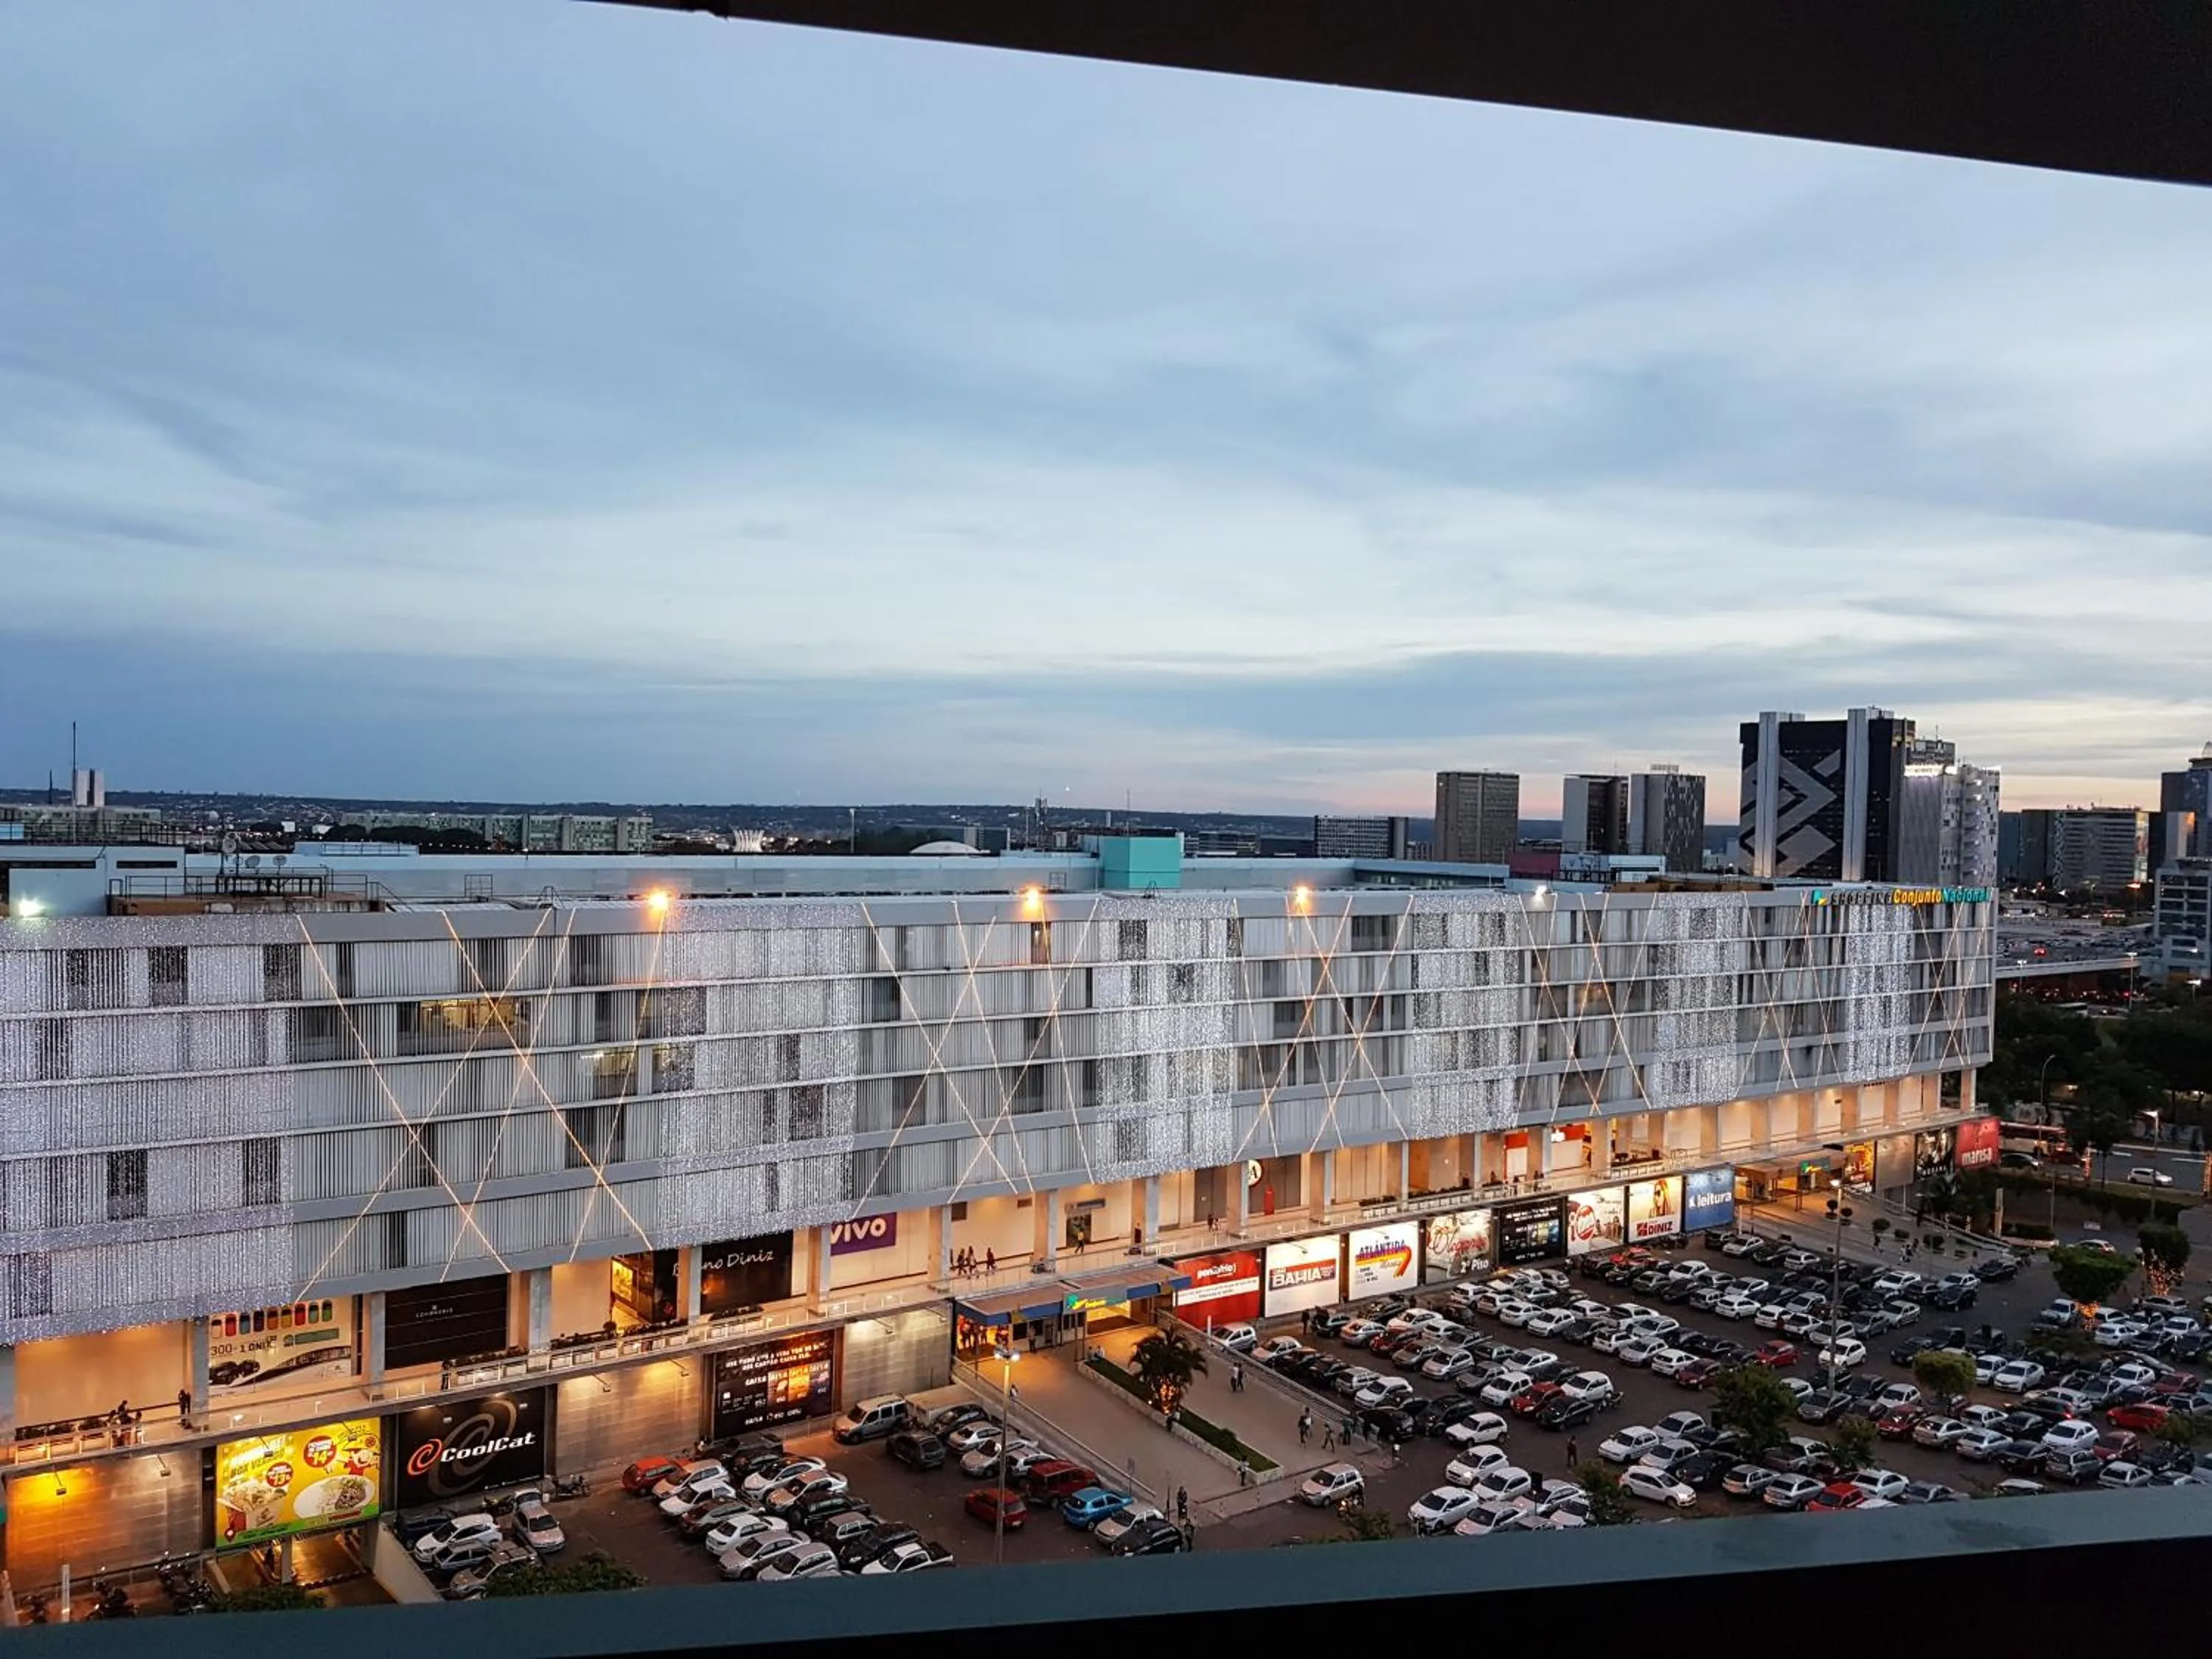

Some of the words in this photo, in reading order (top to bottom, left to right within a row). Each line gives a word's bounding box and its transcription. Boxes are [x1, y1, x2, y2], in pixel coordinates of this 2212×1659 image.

[1962, 1147, 1992, 1165] marisa
[1697, 1192, 1732, 1207] leitura
[1648, 1221, 1673, 1235] DINIZ
[727, 1249, 773, 1267] Diniz
[1272, 1267, 1322, 1287] BAHIA
[440, 1432, 536, 1463] CoolCat
